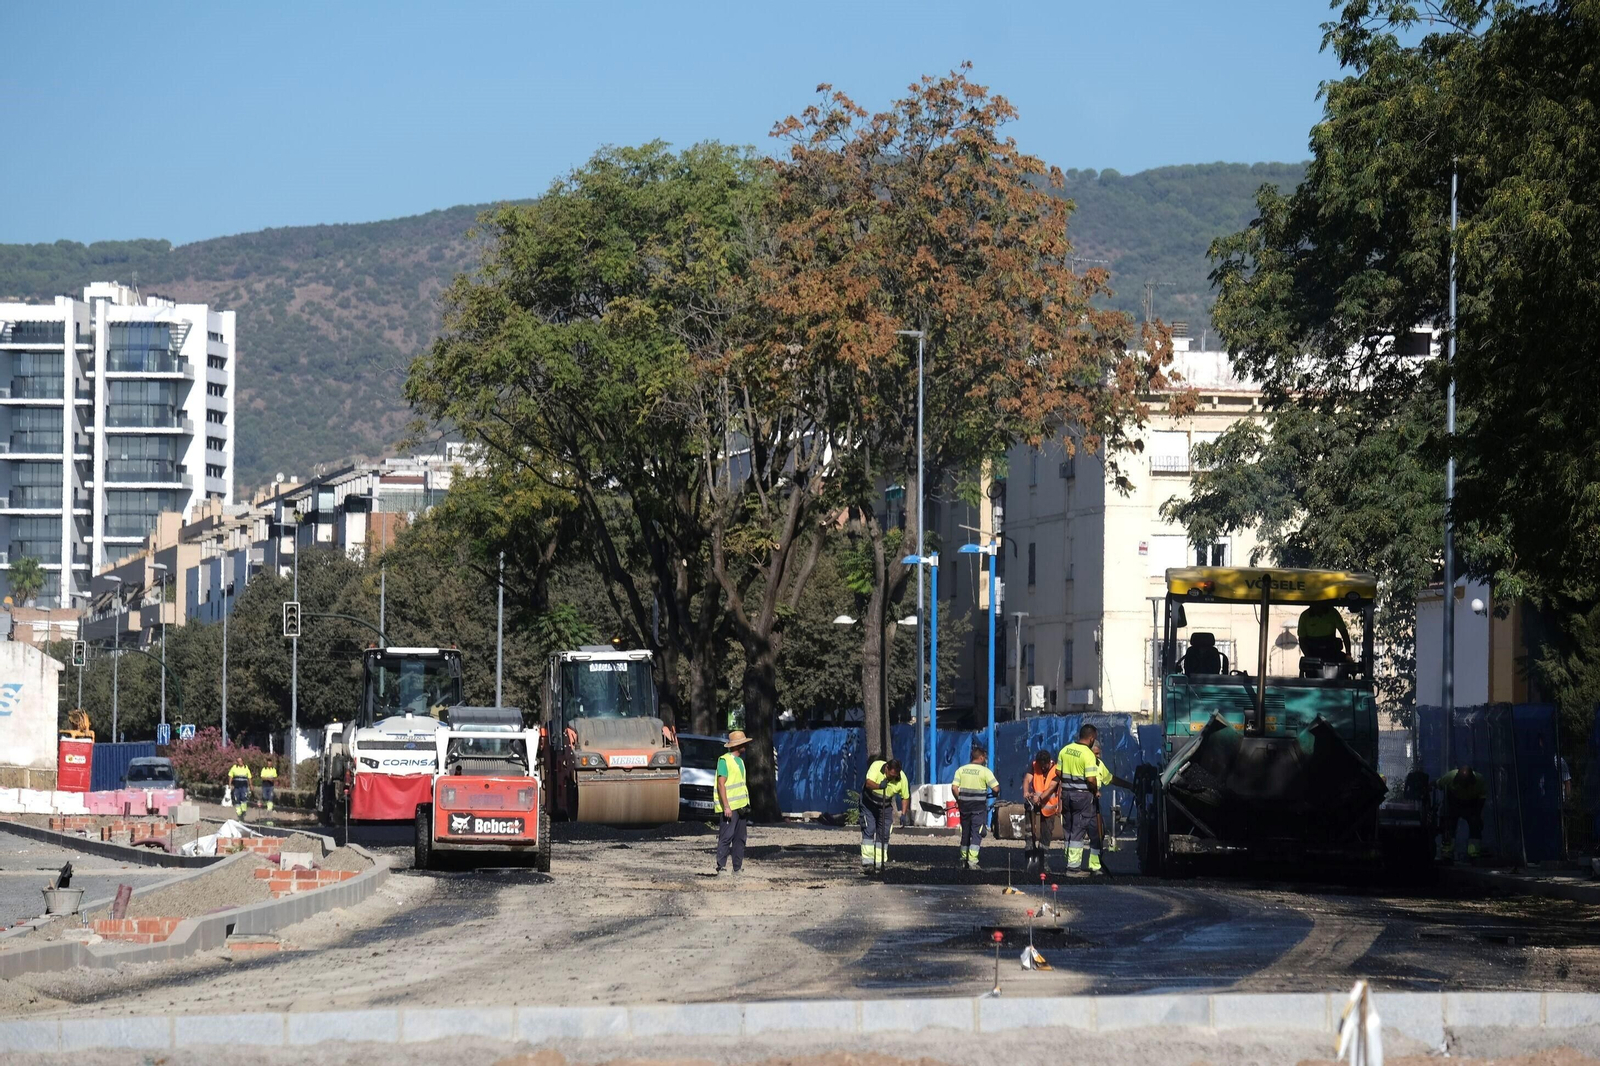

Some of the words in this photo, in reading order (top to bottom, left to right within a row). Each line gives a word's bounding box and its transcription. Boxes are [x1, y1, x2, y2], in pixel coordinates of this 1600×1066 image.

[382, 759, 436, 767] CORINSA
[611, 756, 646, 765] MEBISA
[475, 818, 521, 834] Bobcat
